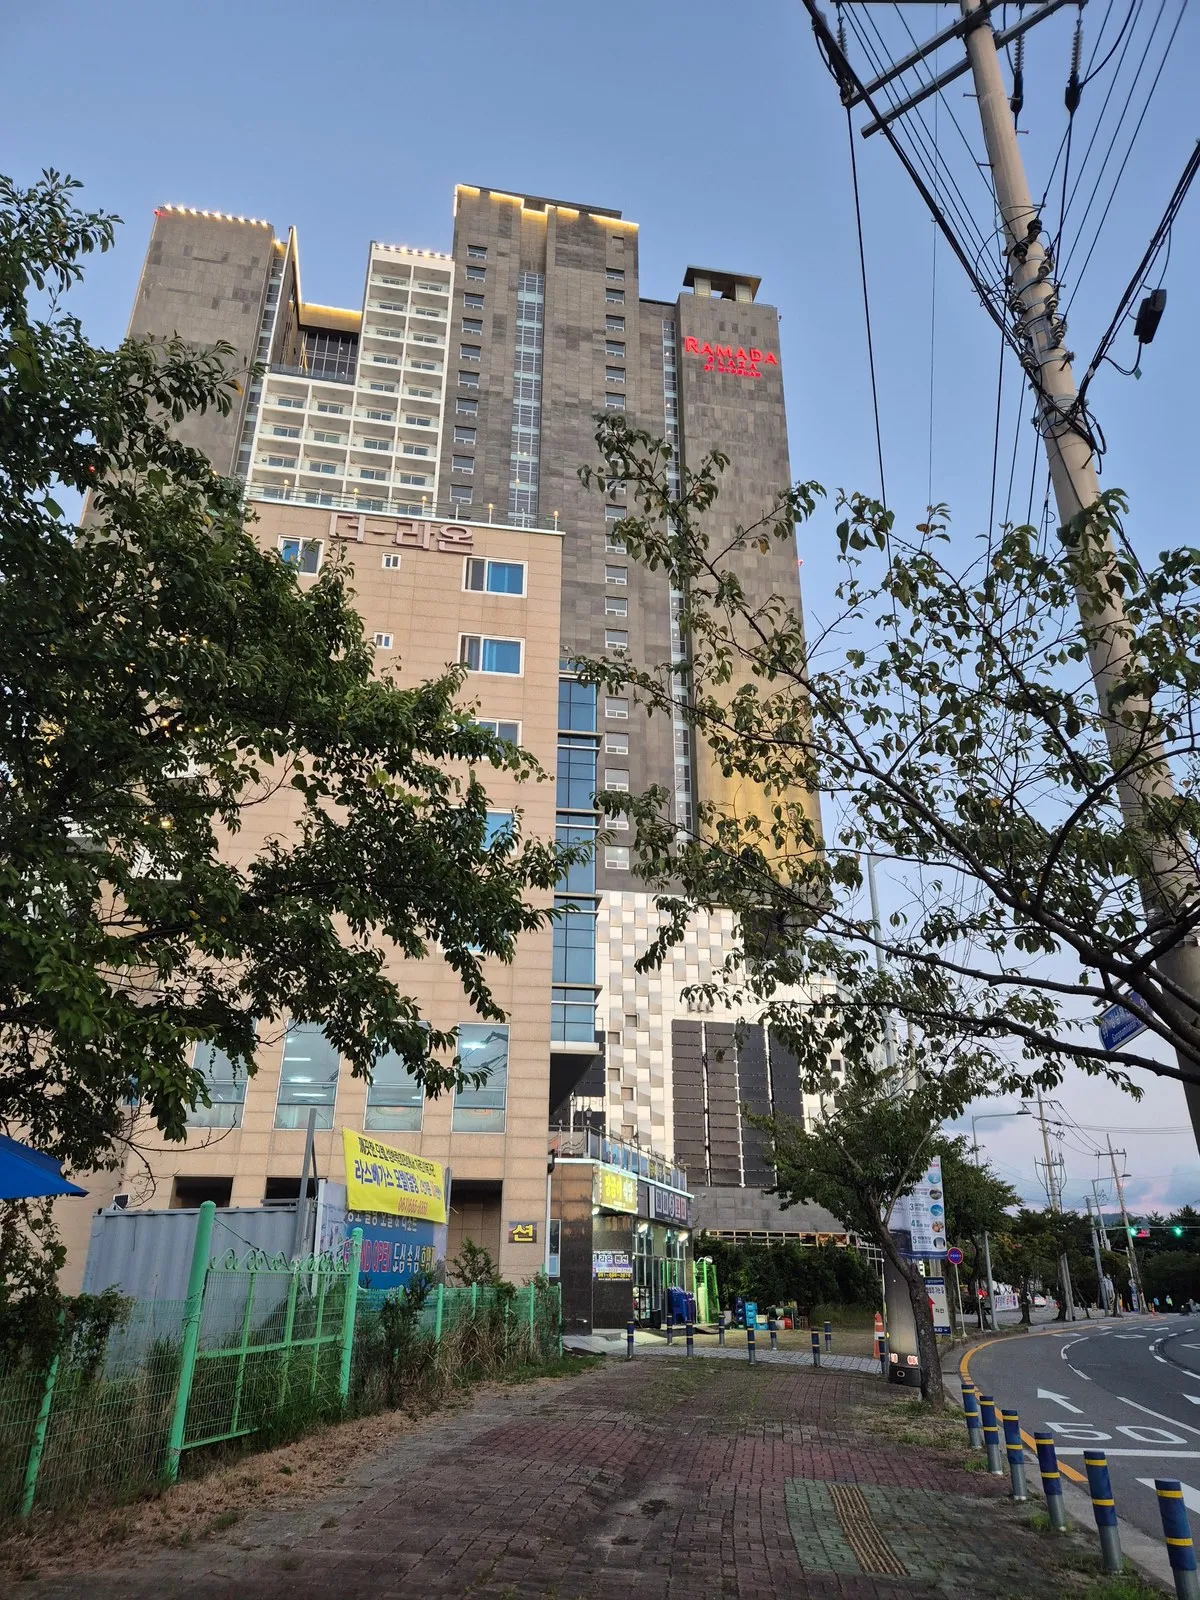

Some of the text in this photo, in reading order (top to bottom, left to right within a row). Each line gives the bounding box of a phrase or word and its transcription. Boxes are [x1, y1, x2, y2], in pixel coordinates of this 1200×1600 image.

[685, 337, 778, 365] RAMADA
[707, 355, 757, 371] PLAZA
[354, 1159, 394, 1188] 라스베가스
[512, 1224, 534, 1242] 션
[372, 1240, 393, 1273] OPEN
[1044, 1422, 1188, 1444] 50
